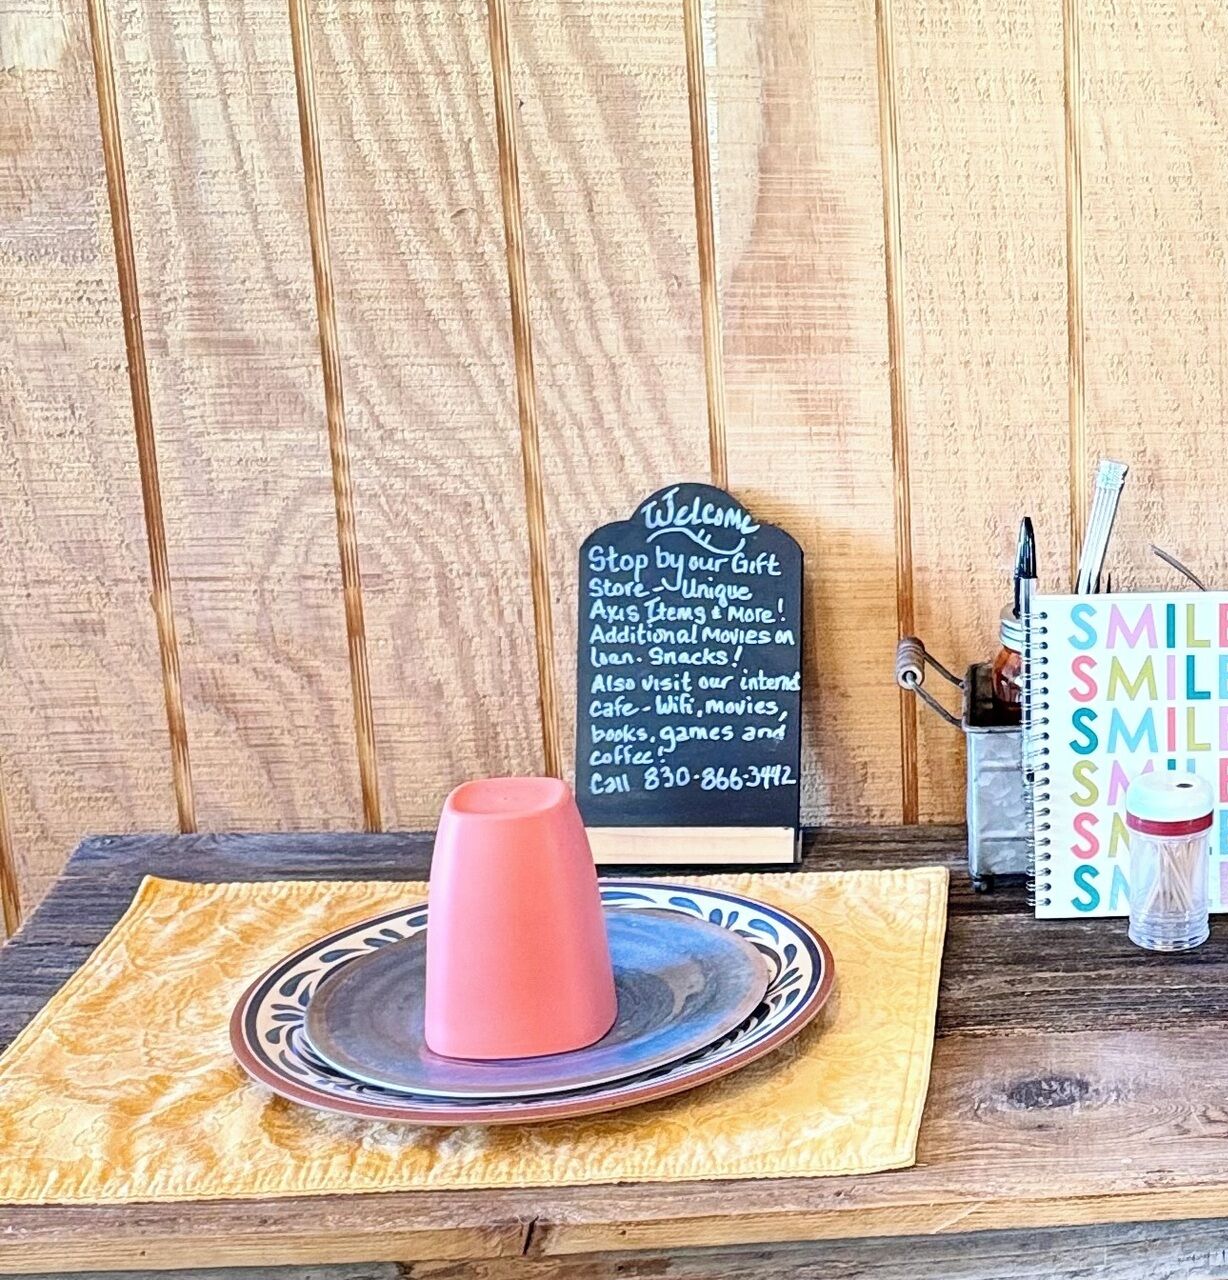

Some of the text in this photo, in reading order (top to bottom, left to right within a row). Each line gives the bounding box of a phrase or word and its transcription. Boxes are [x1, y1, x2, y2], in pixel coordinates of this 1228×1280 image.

[641, 487, 760, 534] Welcome
[588, 545, 782, 591] Stop by our Gift
[682, 577, 752, 607] Unique
[589, 599, 640, 623] Axis
[644, 596, 706, 625] Items
[728, 598, 786, 622] More!
[589, 624, 795, 645] Additional Movies on
[591, 674, 636, 694] Also
[641, 671, 692, 692] visit
[698, 675, 734, 690] our
[659, 725, 734, 752] games
[741, 724, 786, 741] and
[590, 772, 630, 795] Call
